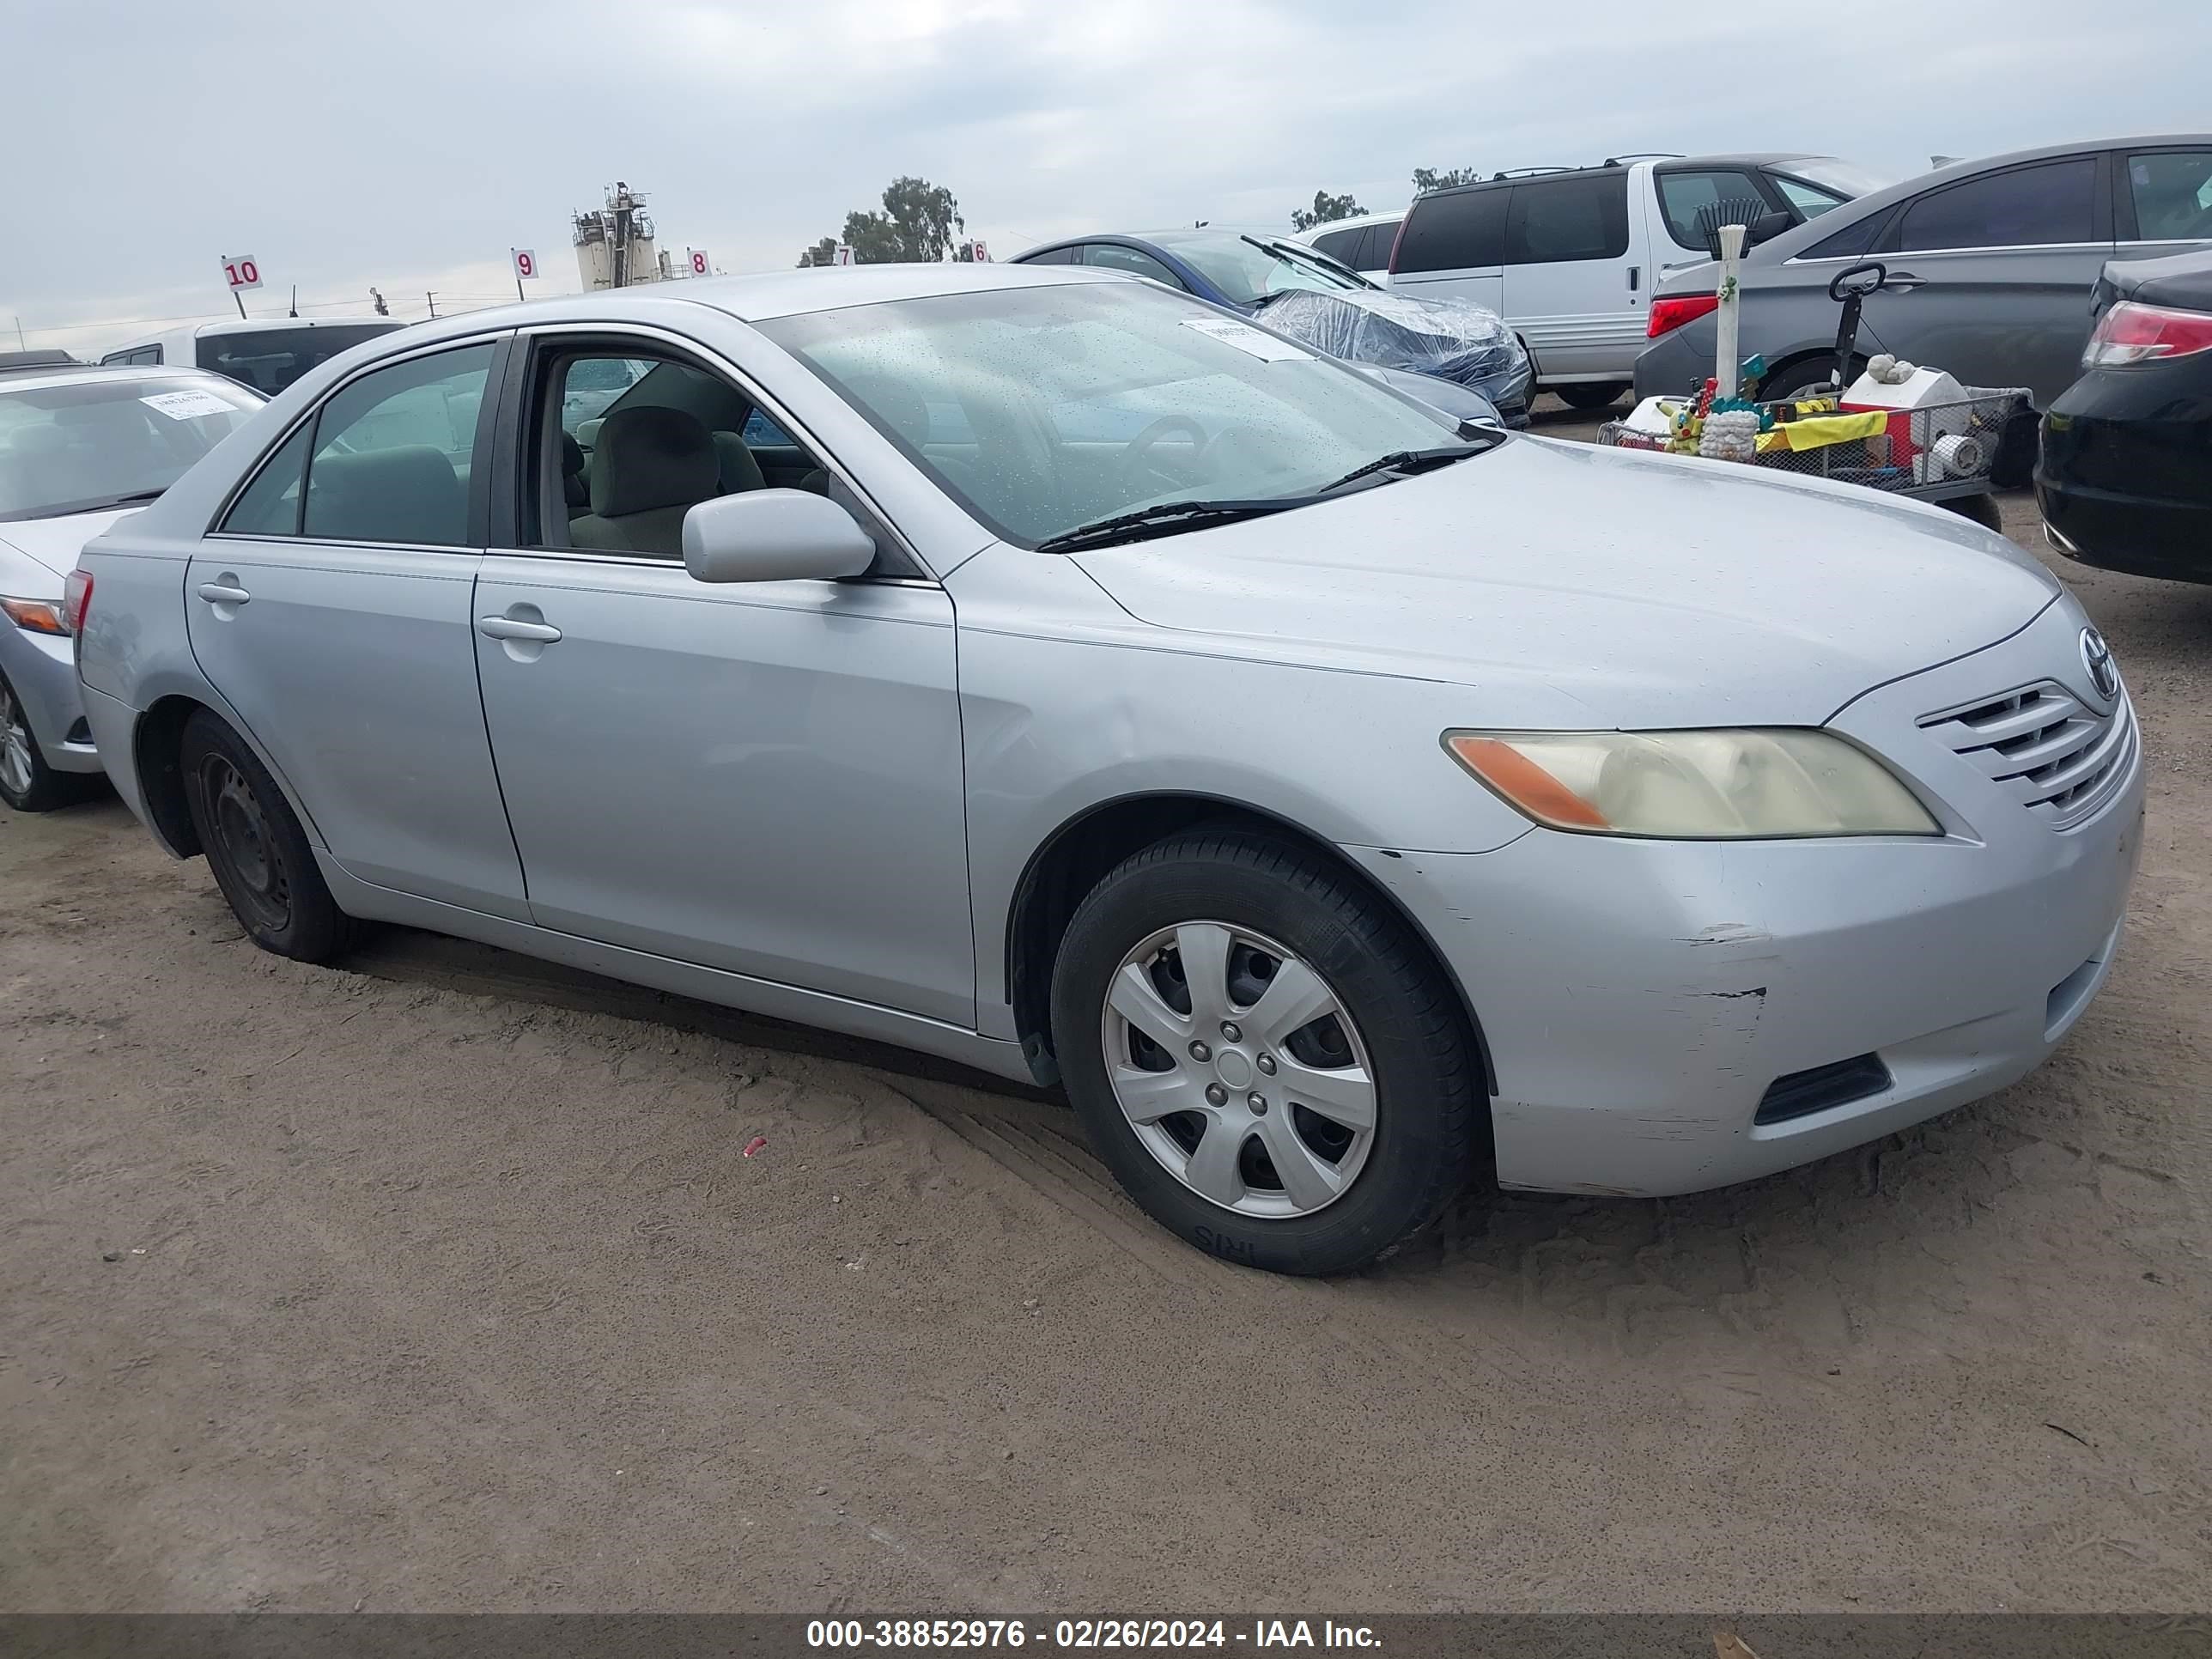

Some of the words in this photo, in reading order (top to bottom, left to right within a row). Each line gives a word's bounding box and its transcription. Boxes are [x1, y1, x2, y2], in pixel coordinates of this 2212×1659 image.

[839, 248, 849, 266] 7
[975, 243, 985, 261] 6
[225, 261, 258, 285] 10
[518, 253, 532, 276] 9
[693, 253, 706, 273] 8
[1194, 1224, 1257, 1264] IRIS
